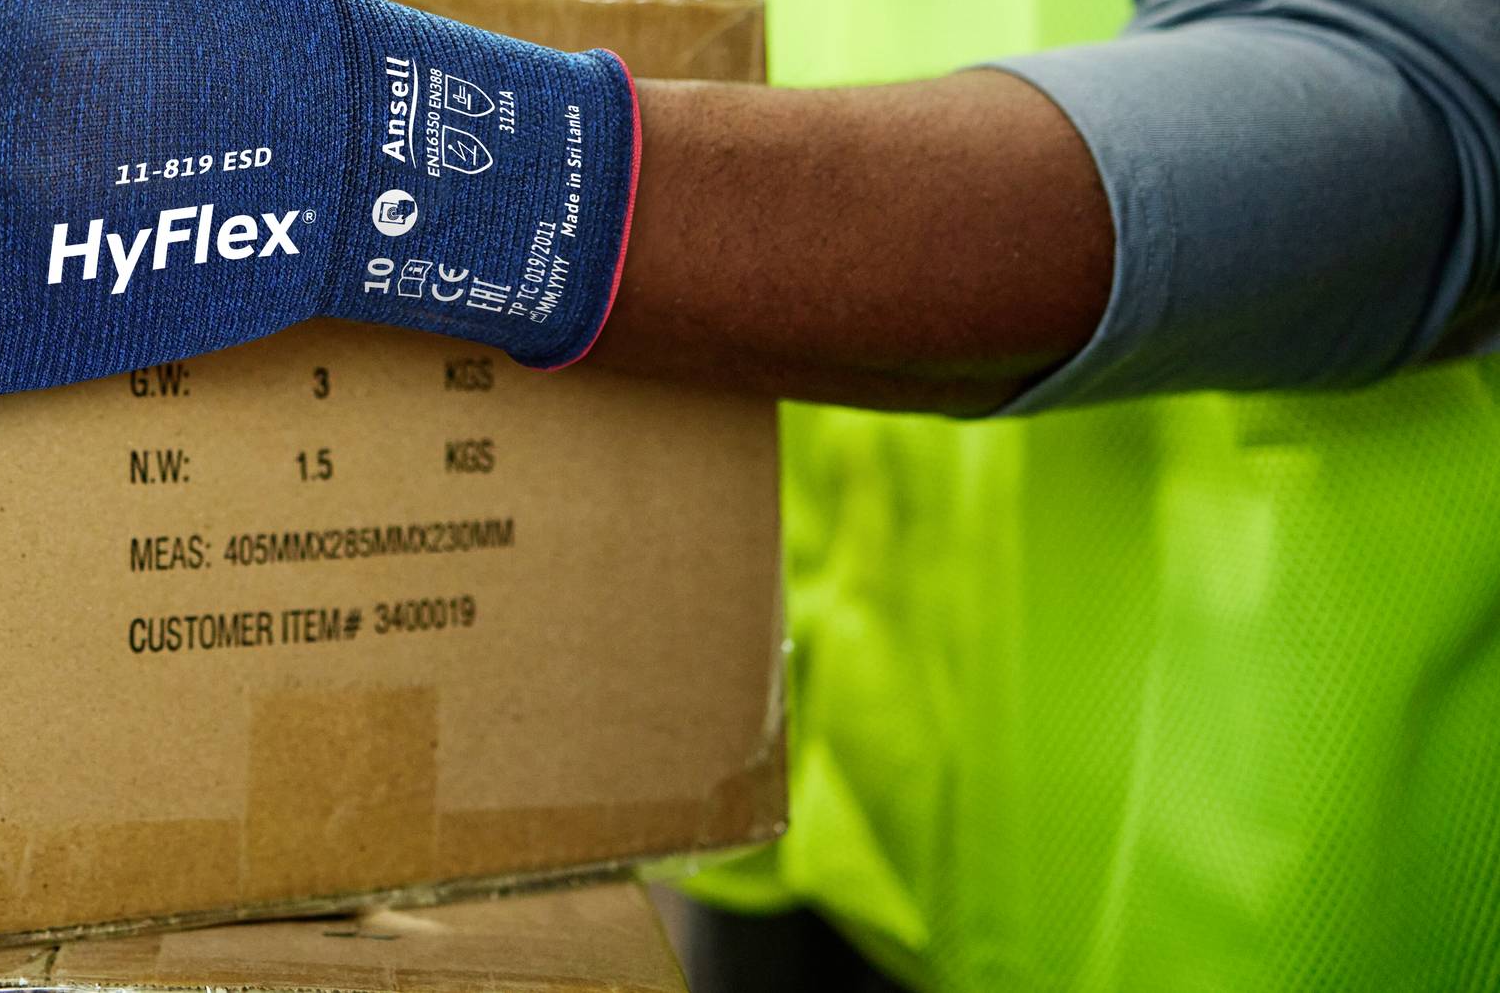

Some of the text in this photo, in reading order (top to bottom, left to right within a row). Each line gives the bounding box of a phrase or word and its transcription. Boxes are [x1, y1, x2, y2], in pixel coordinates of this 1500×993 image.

[382, 56, 409, 163] Ansell
[426, 68, 443, 177] EN16350 EN388
[499, 90, 515, 134] 3121A
[115, 147, 272, 185] 11-819 ESD
[560, 105, 582, 237] Made in Sri Lanka
[364, 258, 395, 294] 10
[527, 221, 557, 282] 019/2011
[312, 367, 329, 400] 3
[445, 358, 494, 391] KGS
[130, 438, 495, 484] N.W: 1.5 KGS
[130, 517, 514, 572] MEAS: 405MMX285MMX230MM
[129, 596, 476, 654] CUSTOMER ITEM# 3400019
